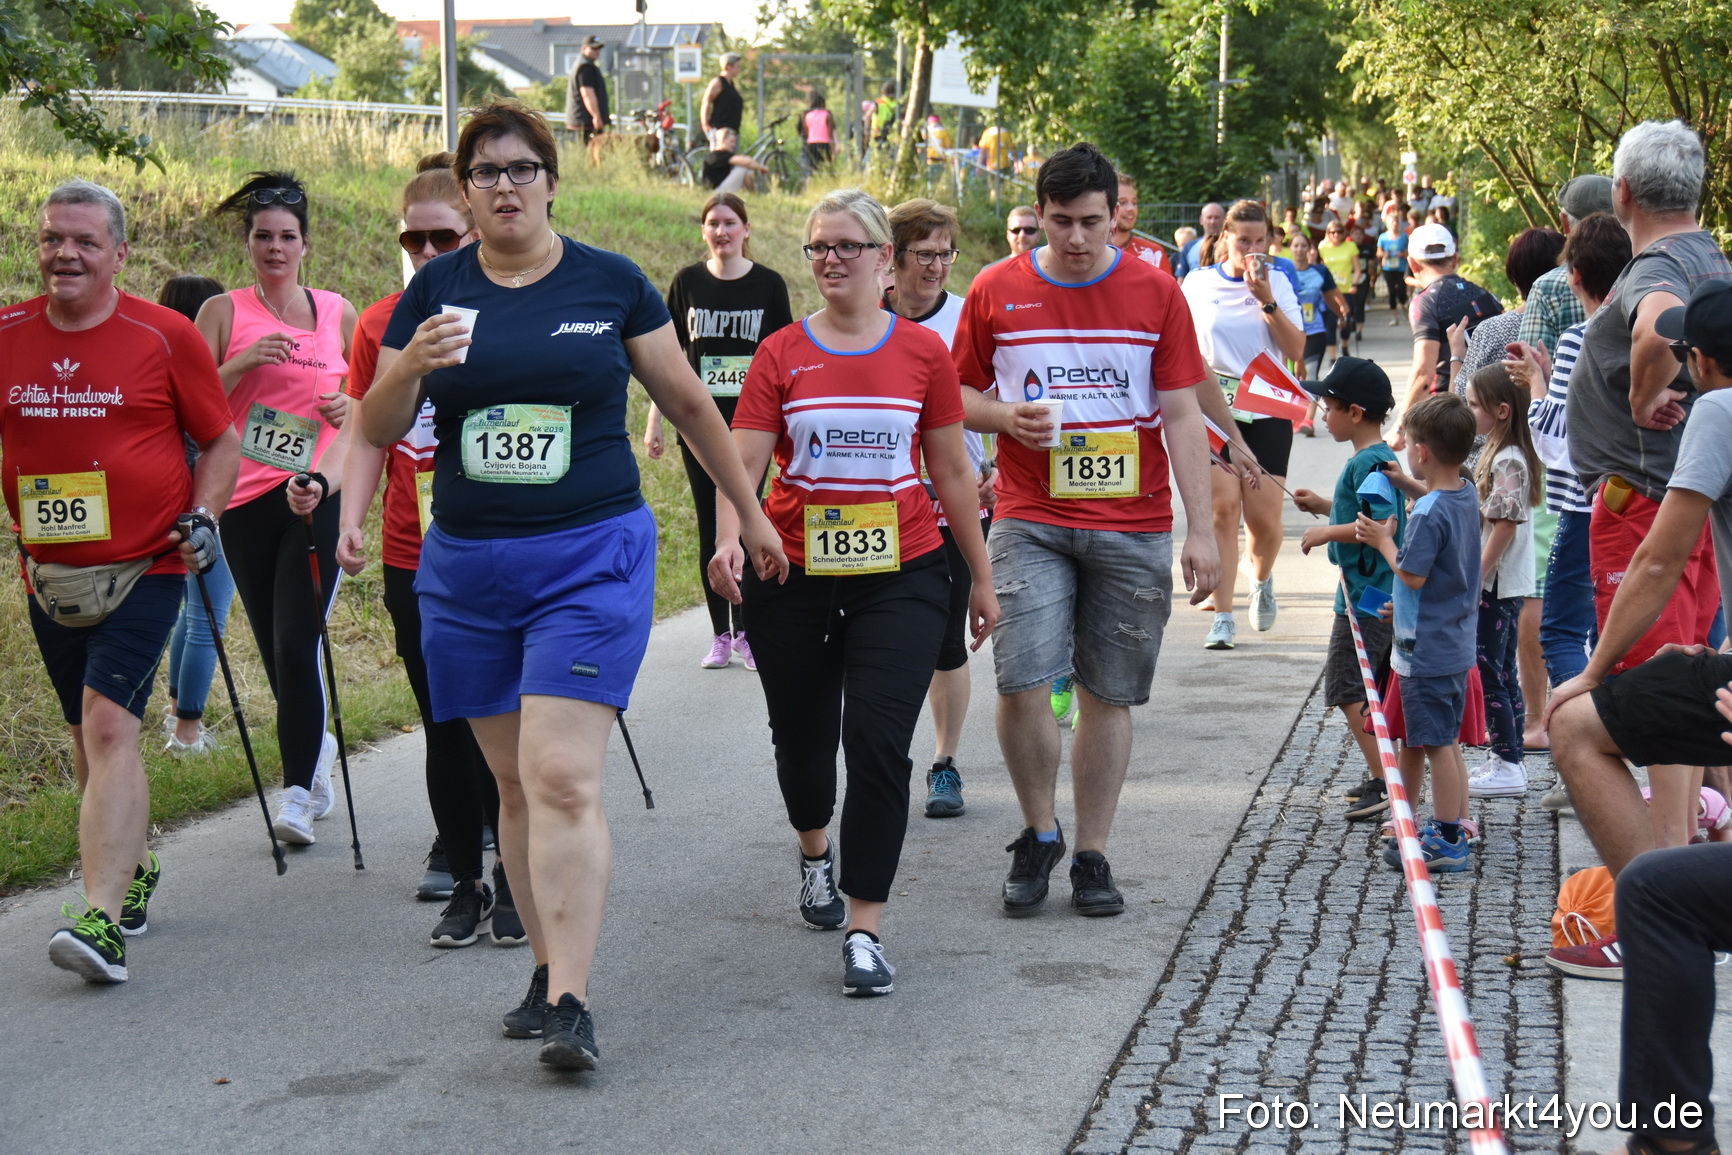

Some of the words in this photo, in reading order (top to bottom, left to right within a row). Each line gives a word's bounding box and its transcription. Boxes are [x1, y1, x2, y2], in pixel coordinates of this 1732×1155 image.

[687, 306, 764, 343] COMPTON
[707, 371, 747, 385] 2448
[1047, 366, 1130, 389] Petry
[8, 383, 51, 404] Echtes
[52, 384, 124, 406] Handwerk
[21, 407, 59, 418] IMMER
[63, 407, 106, 418] FRISCH
[479, 419, 520, 427] firmenlauf
[252, 424, 306, 457] 1125
[476, 432, 556, 461] 1387
[826, 429, 900, 451] Petry
[271, 451, 296, 463] Johanna
[484, 461, 517, 471] Cvijovic
[518, 462, 547, 471] Bojana
[1062, 455, 1125, 480] 1831
[37, 498, 87, 524] 596
[818, 518, 855, 526] firmenlauf
[57, 523, 86, 531] Manfred
[817, 528, 887, 555] 1833
